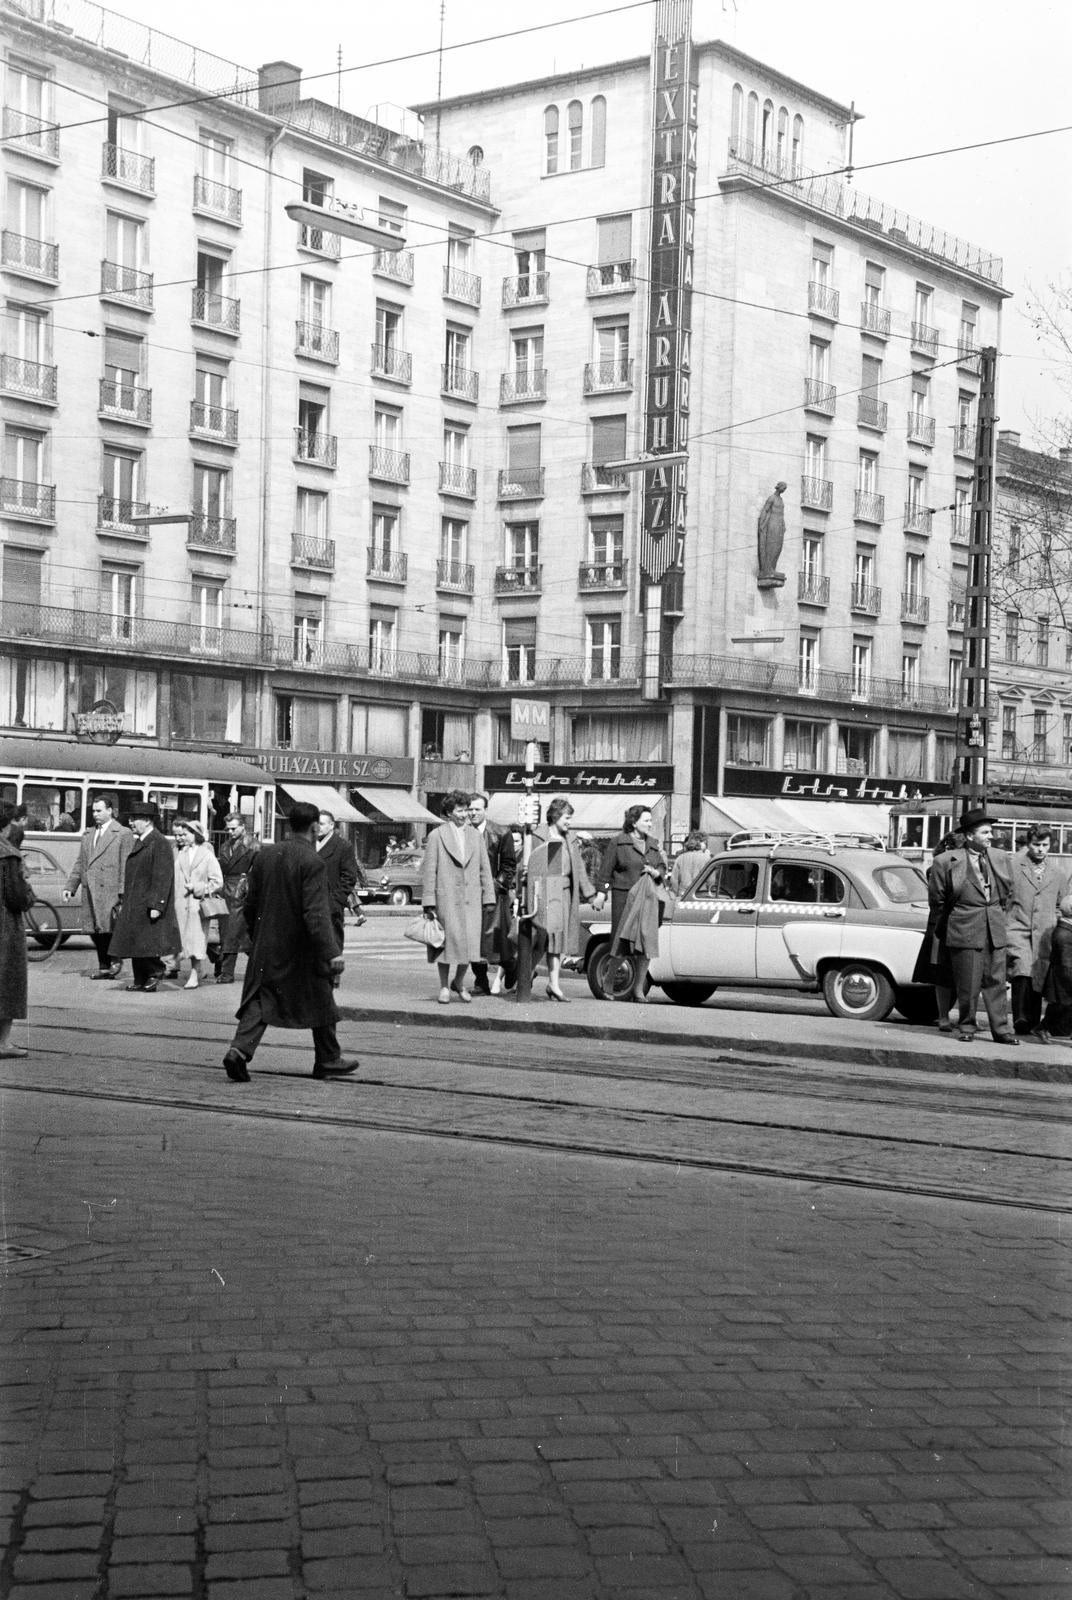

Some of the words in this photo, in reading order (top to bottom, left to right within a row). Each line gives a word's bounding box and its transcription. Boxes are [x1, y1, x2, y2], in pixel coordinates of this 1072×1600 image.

[658, 47, 678, 246] EXTRA
[684, 89, 697, 286] EXTRA
[514, 703, 547, 726] MM
[259, 754, 334, 775] RUHÁZATI
[781, 776, 848, 797] Extra
